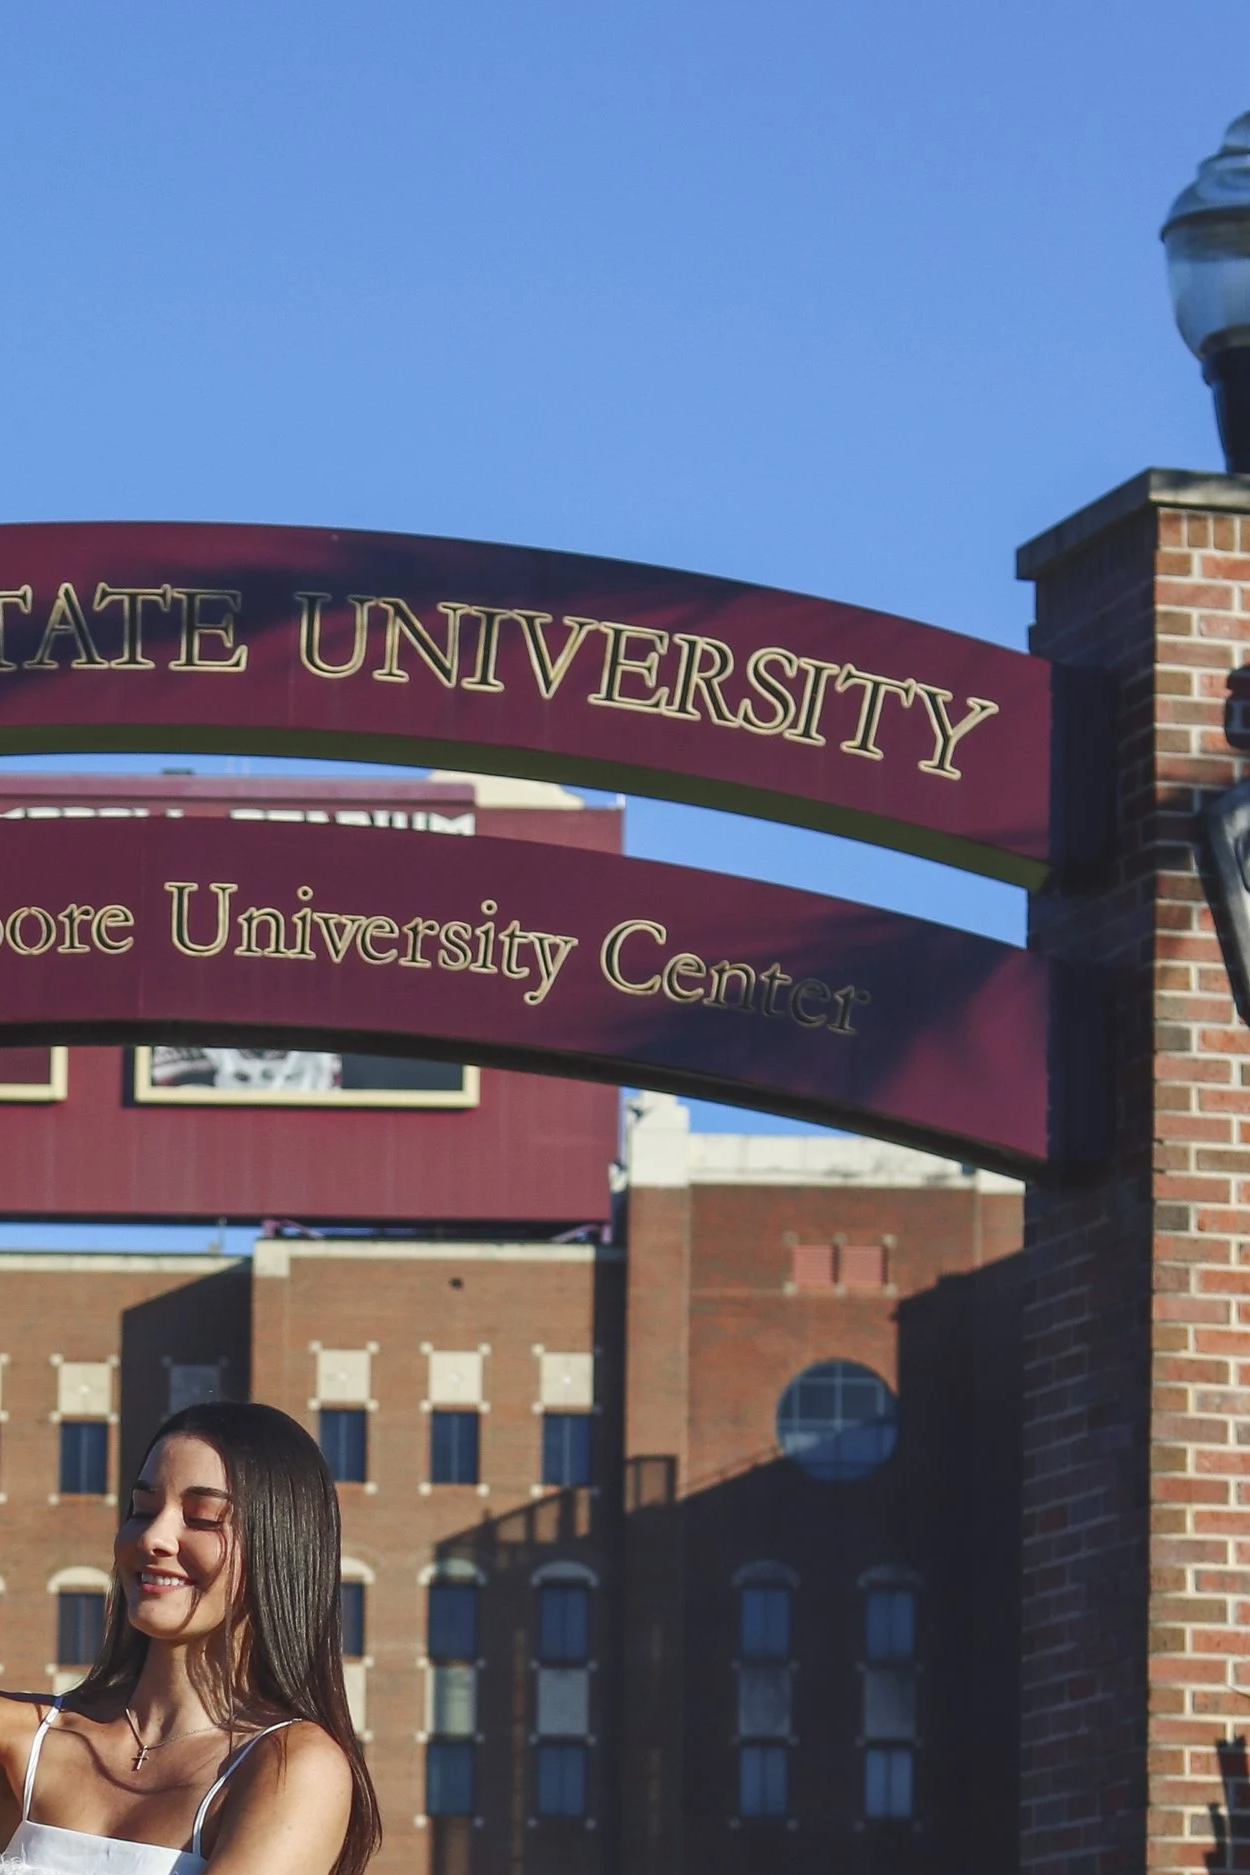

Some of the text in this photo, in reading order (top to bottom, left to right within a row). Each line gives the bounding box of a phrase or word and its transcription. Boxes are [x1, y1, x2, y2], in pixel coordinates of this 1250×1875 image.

[295, 592, 999, 780] UNIVERSITY
[165, 883, 578, 1004] University
[601, 920, 871, 1034] Center
